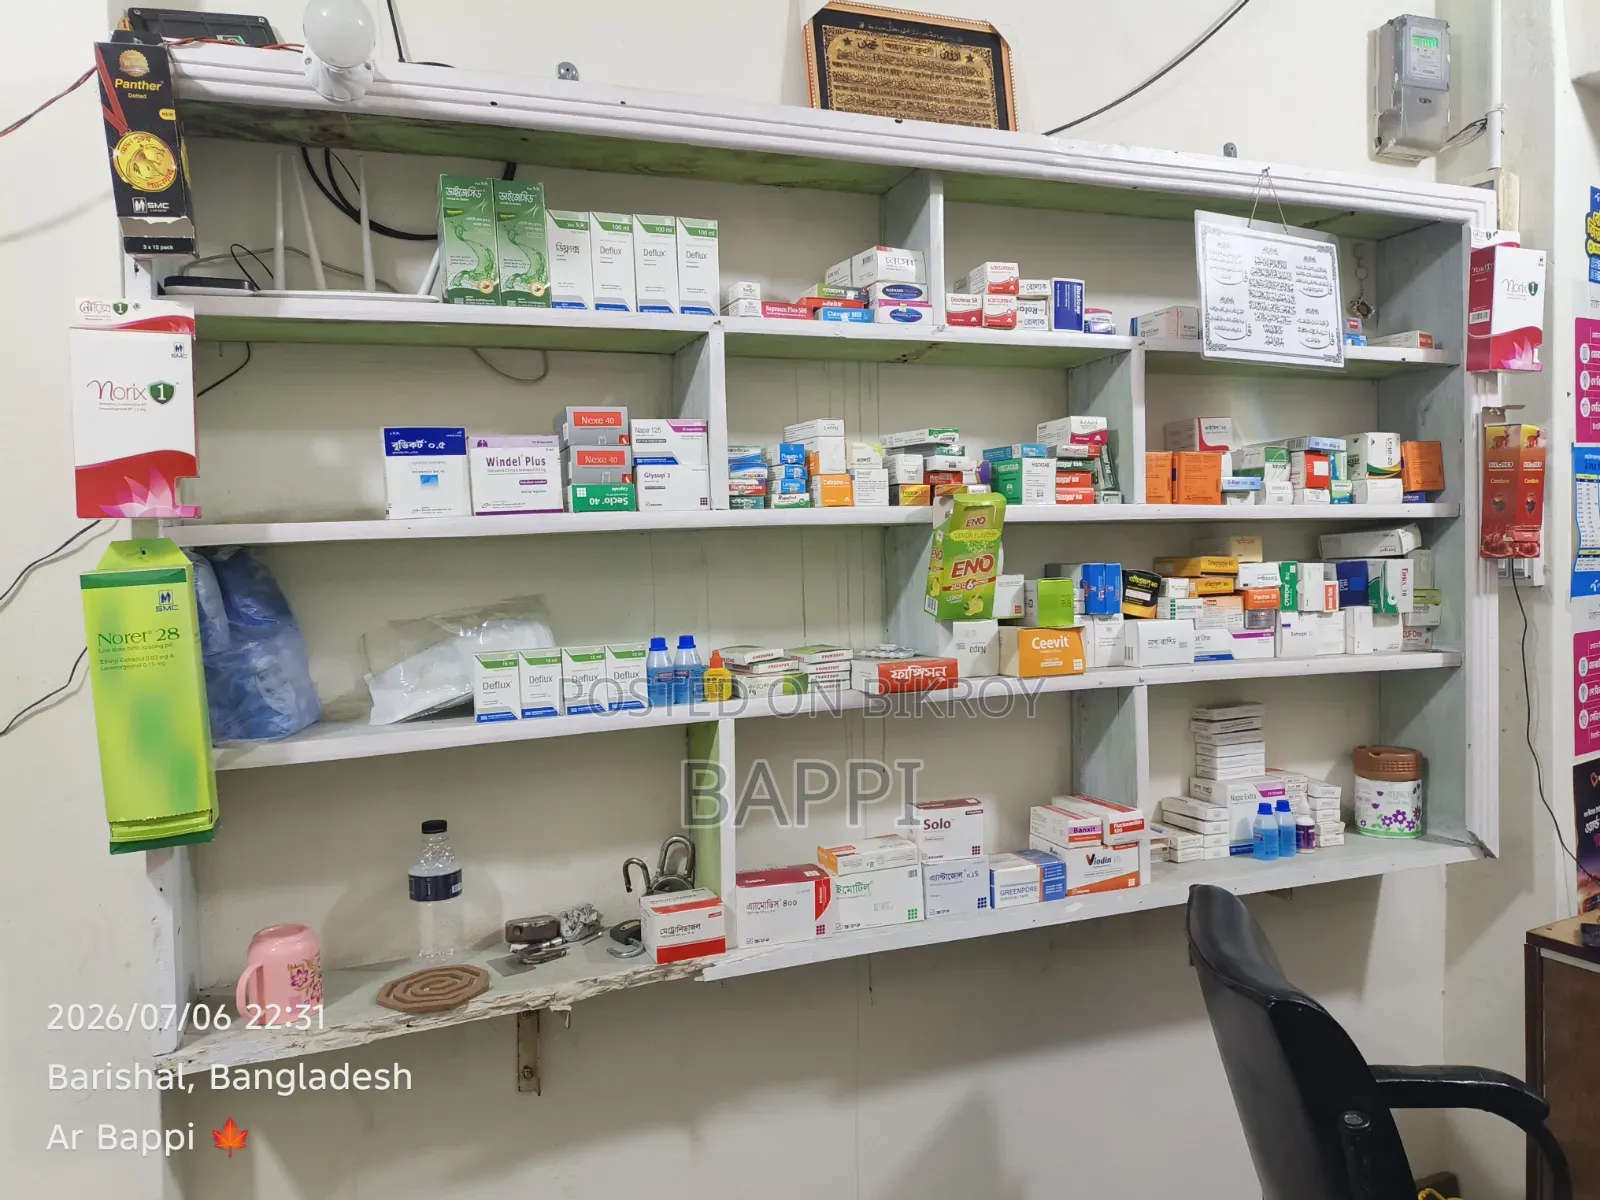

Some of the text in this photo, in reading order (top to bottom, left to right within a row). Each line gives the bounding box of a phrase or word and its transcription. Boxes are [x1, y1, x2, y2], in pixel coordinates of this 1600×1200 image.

[115, 78, 162, 91] Panther
[600, 246, 622, 255] Deflux
[643, 248, 666, 257] Deflux
[686, 250, 708, 260] Deflux
[1502, 278, 1529, 294] Norix
[86, 380, 147, 401] Norix
[582, 416, 603, 424] Nexe
[635, 426, 650, 434] Napa
[428, 442, 446, 450] ০.৫
[486, 456, 546, 467] Windel Plus
[585, 456, 607, 464] Nexe
[998, 463, 1019, 472] HISTATAB
[604, 497, 629, 506] Seclo
[966, 516, 986, 527] ENO
[931, 549, 943, 560] ENO
[951, 554, 994, 579] ENO
[966, 578, 975, 590] 6
[98, 628, 180, 646] Noret 28
[1031, 635, 1069, 650] Ceevit
[969, 646, 987, 654] Napa
[529, 675, 553, 684] Deflux
[572, 673, 599, 683] Deflux
[613, 670, 640, 680] Deflux
[482, 680, 512, 691] Deflux
[1231, 794, 1243, 802] Napa
[923, 819, 951, 830] Solo
[1073, 826, 1096, 834] Banxit
[1086, 854, 1112, 866] Viodin
[835, 882, 871, 895] ইমোটিল
[1000, 885, 1038, 896] GREENPORE
